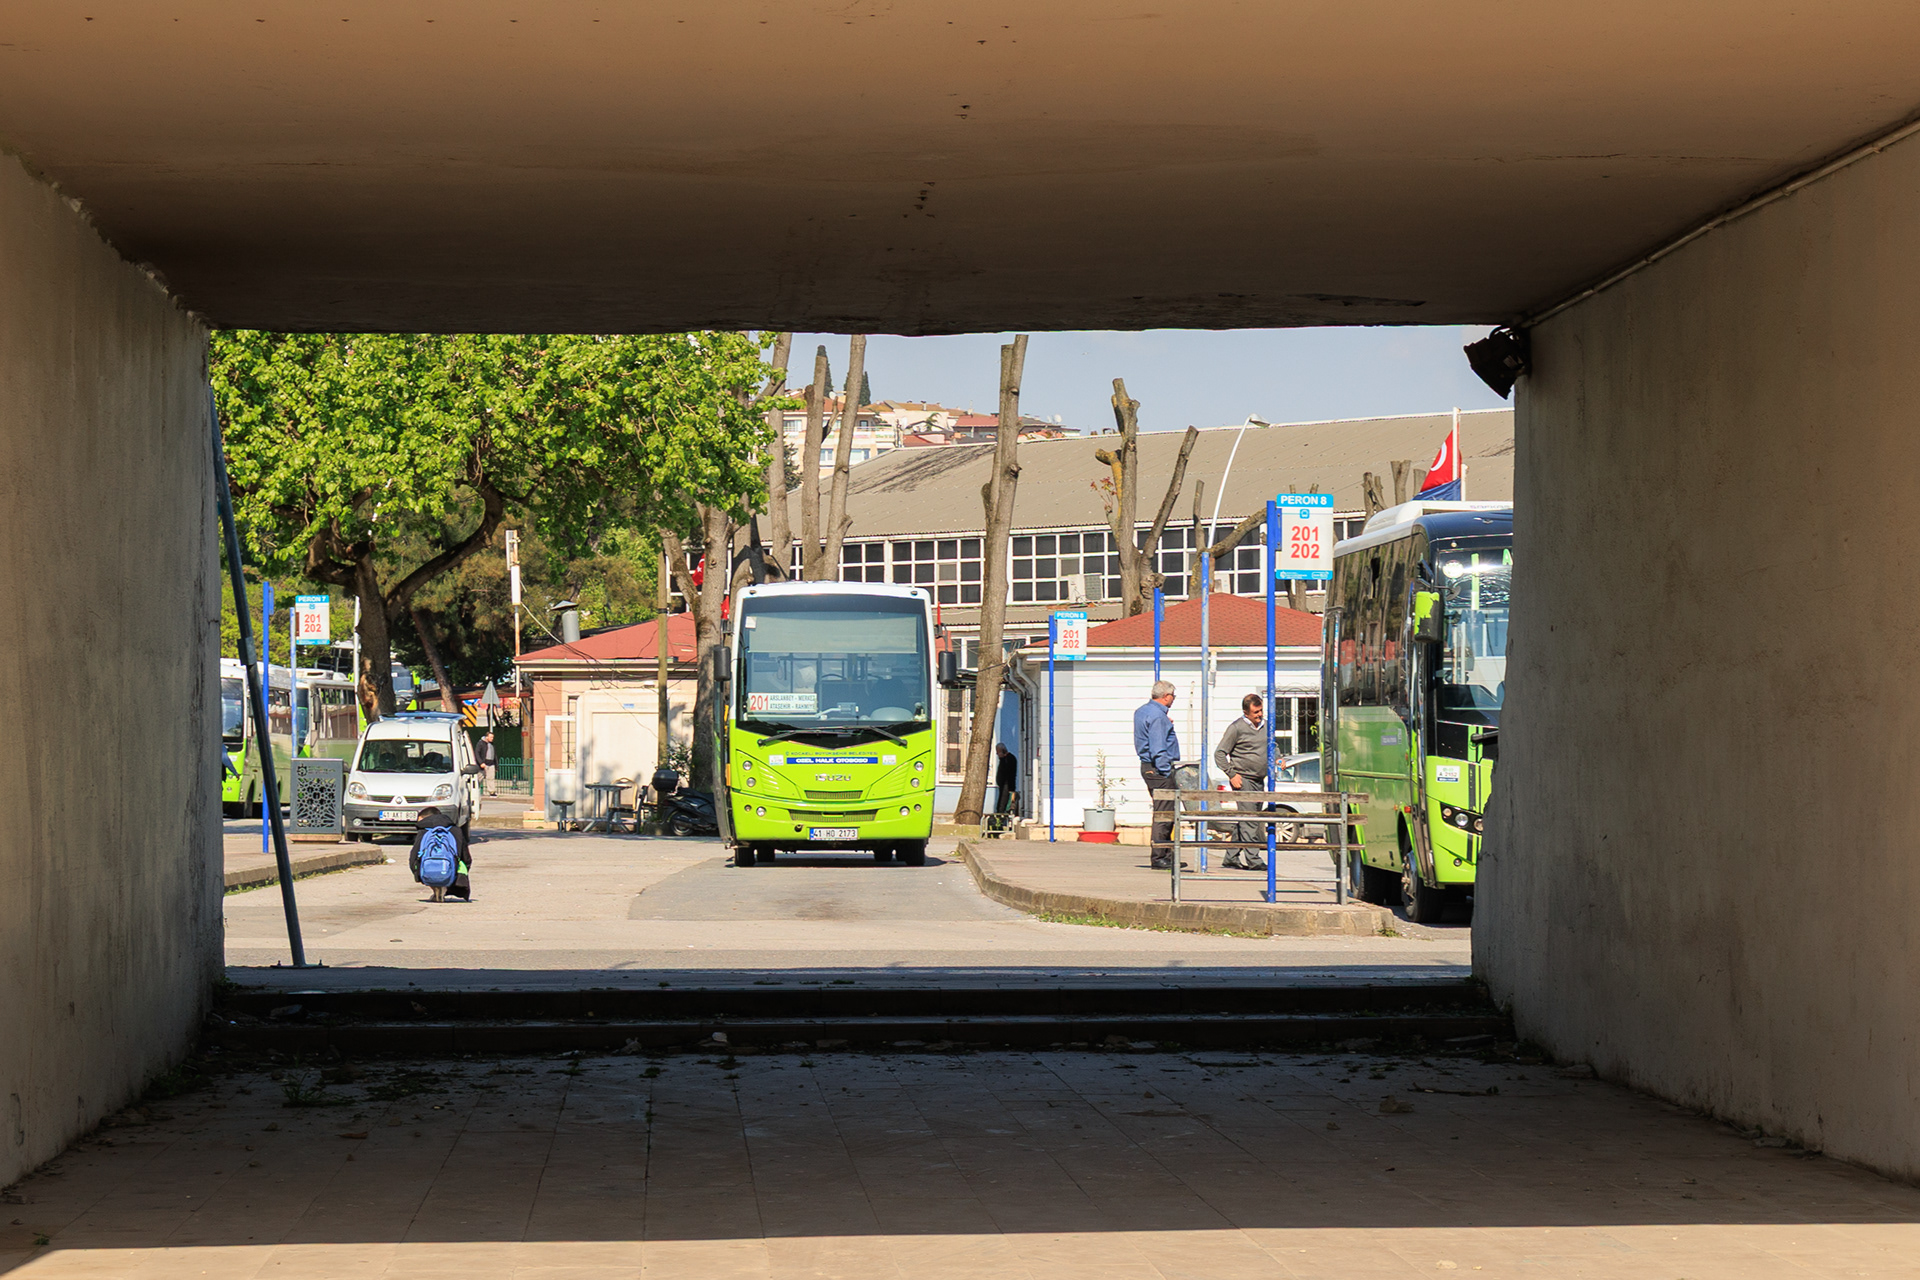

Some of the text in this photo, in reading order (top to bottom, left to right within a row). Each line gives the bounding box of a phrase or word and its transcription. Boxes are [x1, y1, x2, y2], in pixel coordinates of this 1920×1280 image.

[1280, 495, 1328, 505] PERON 8
[1291, 525, 1319, 542] 201
[1290, 543, 1320, 559] 202
[304, 613, 321, 623] 201
[304, 623, 322, 633] 202
[1063, 629, 1079, 638] 201
[1062, 639, 1080, 648] 202
[750, 695, 769, 711] 201
[815, 773, 852, 781] ISUZU
[813, 829, 822, 837] 41
[839, 829, 856, 837] 2173
